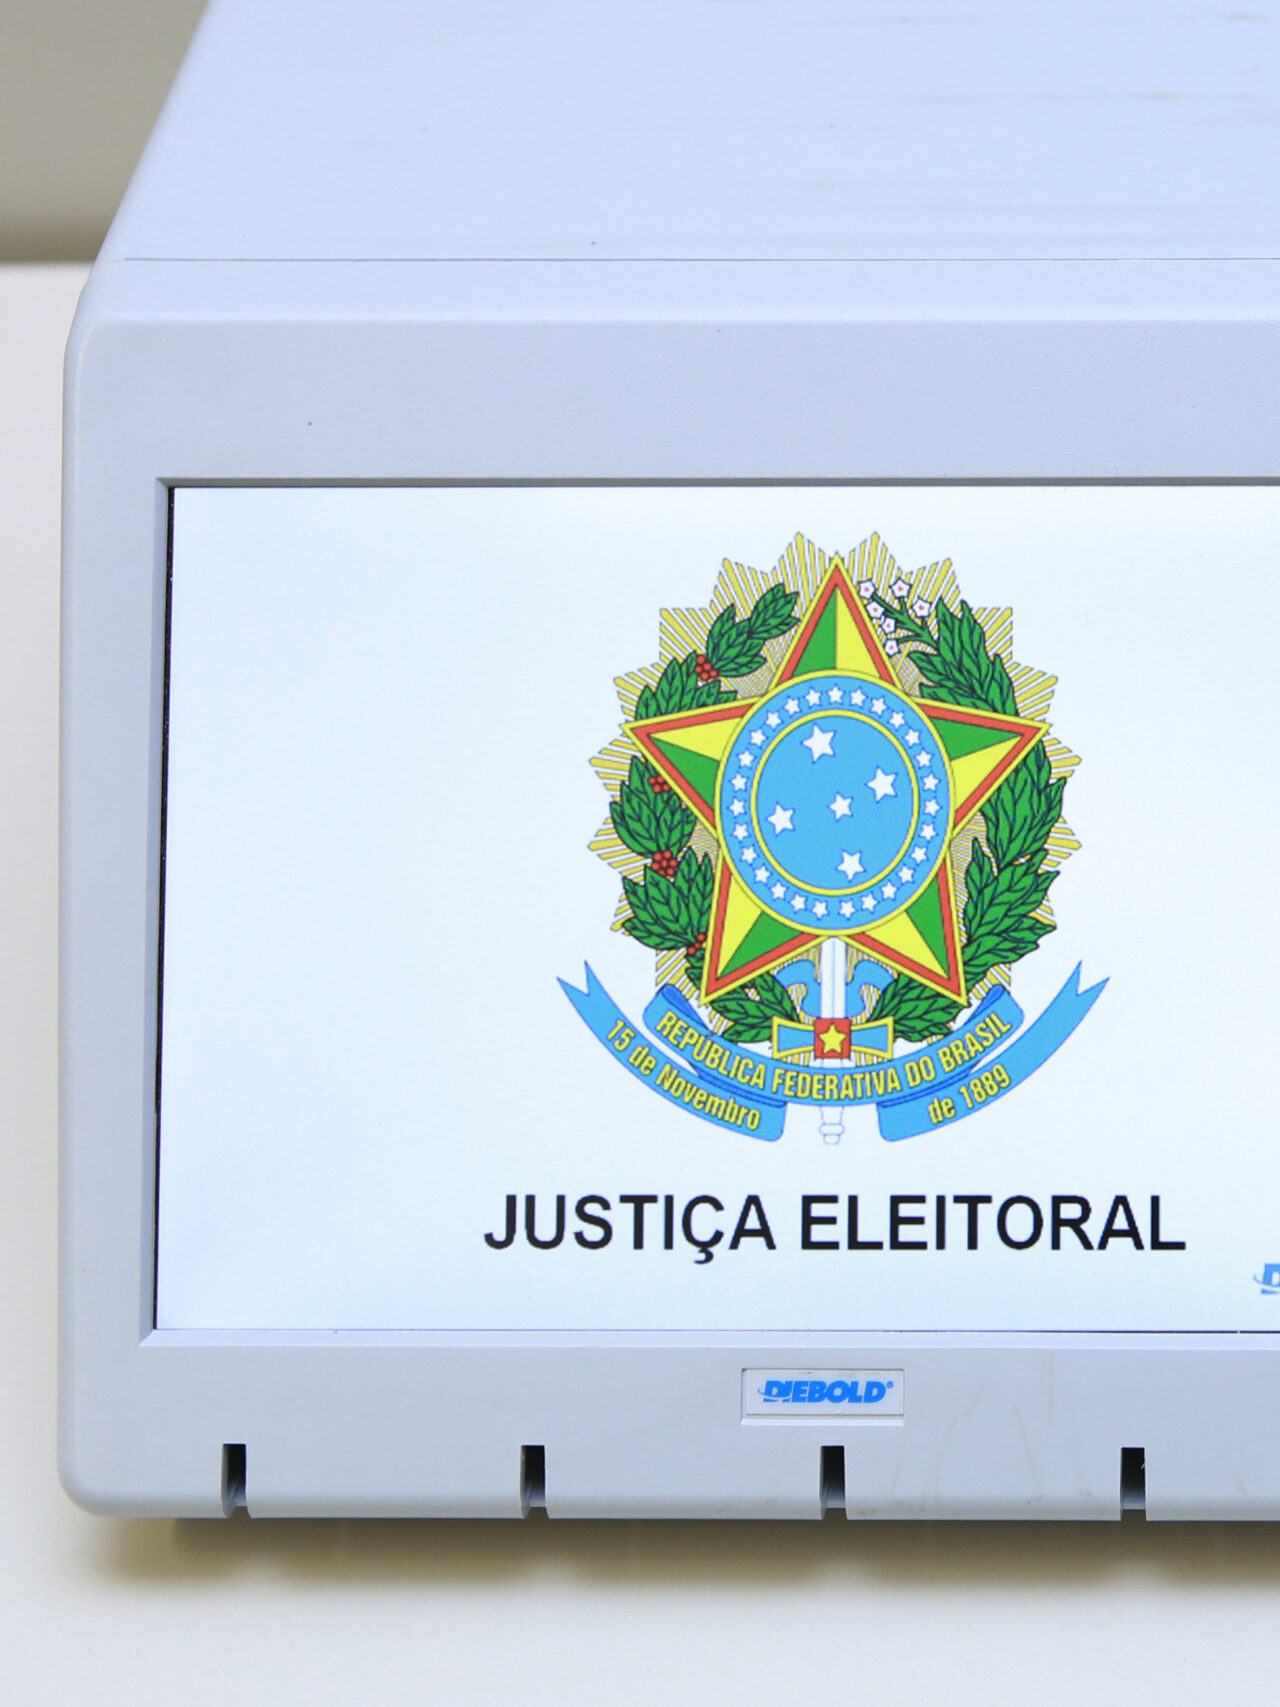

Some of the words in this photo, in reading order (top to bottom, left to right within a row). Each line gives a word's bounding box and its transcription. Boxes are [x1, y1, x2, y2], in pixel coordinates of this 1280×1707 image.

[607, 1019, 636, 1051] 15
[628, 1045, 657, 1076] de
[655, 1063, 762, 1131] Novembro
[771, 1067, 902, 1101] FEDERATIVA
[904, 1056, 935, 1088] DO
[937, 1011, 1012, 1073] BRASIL
[928, 1096, 956, 1125] de
[958, 1063, 1012, 1109] 1889
[484, 1194, 777, 1265] JUSTIÇA
[801, 1194, 1186, 1251] ELEITORAL
